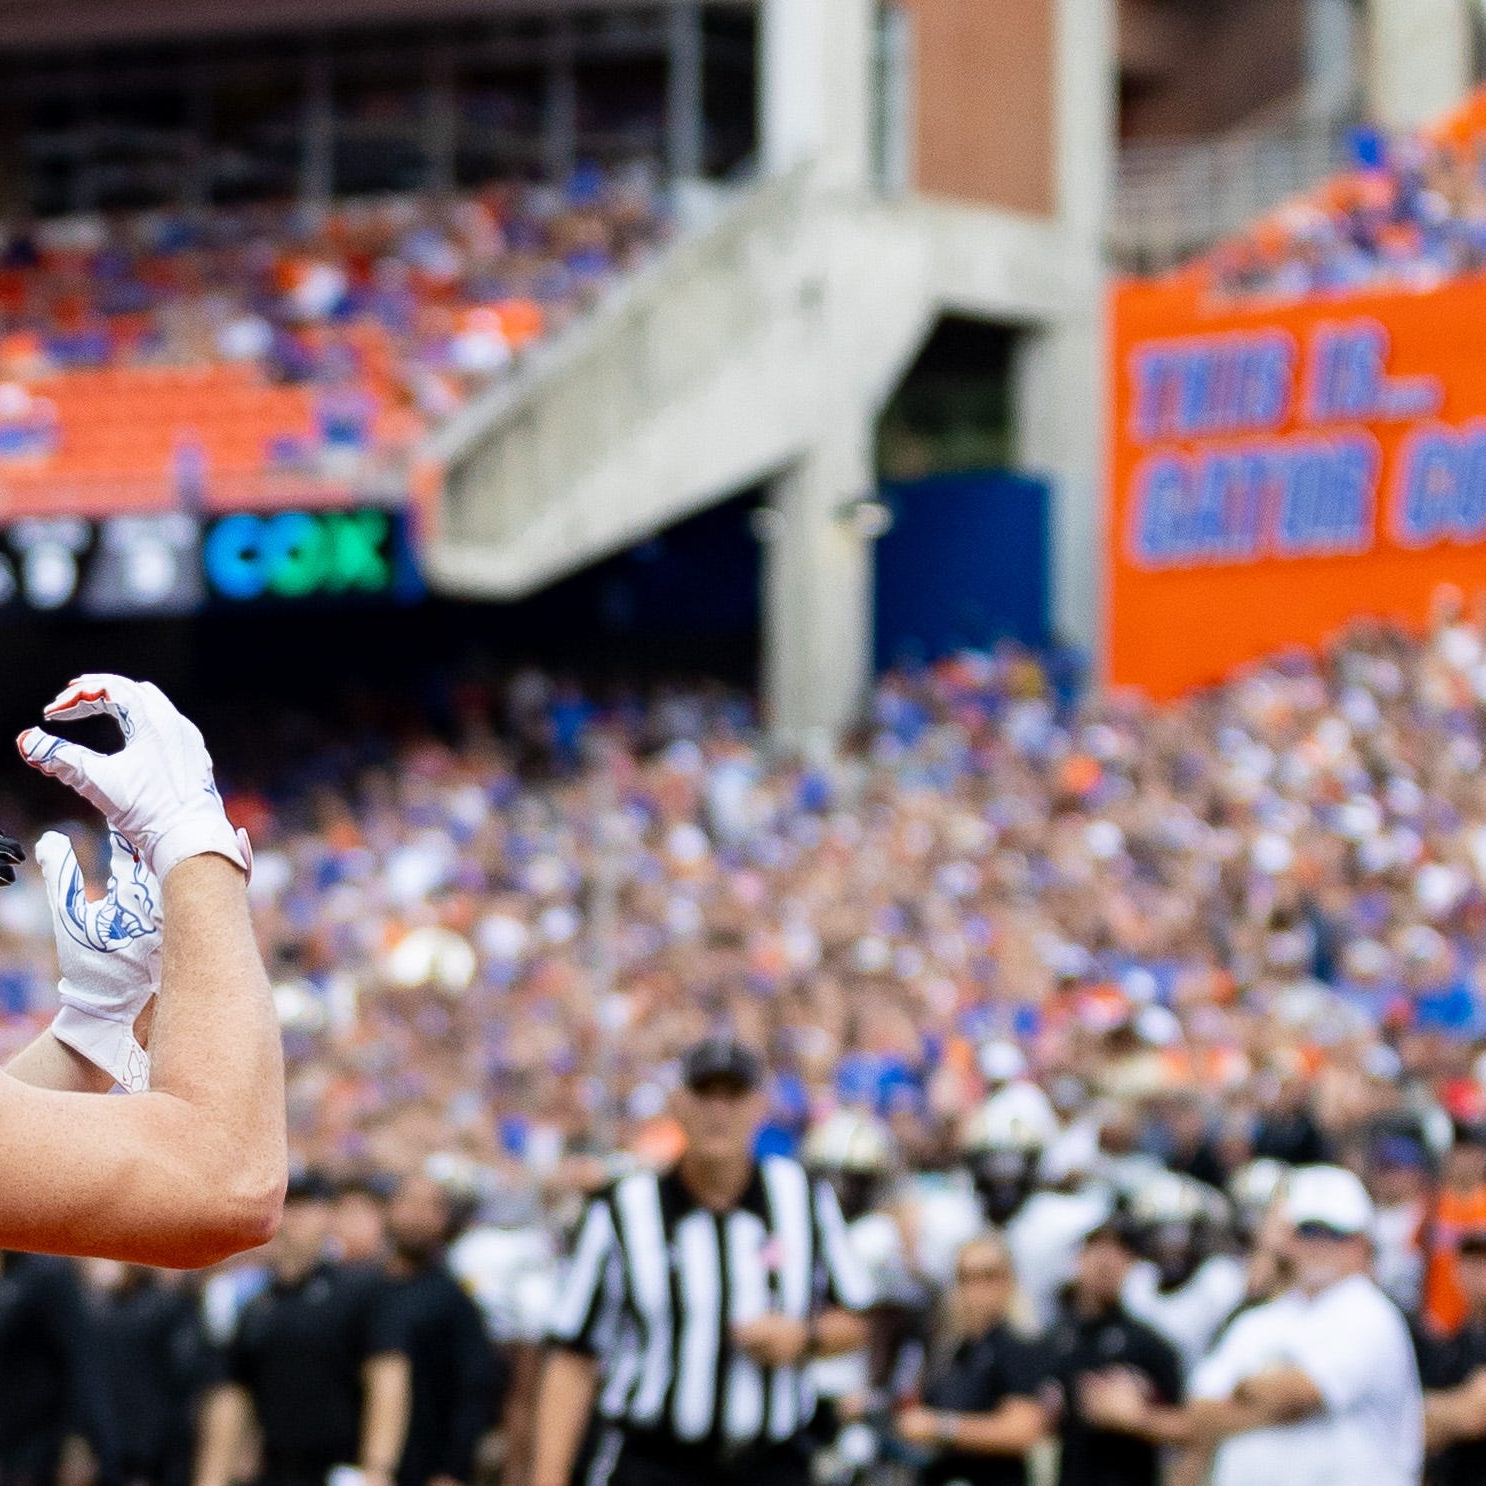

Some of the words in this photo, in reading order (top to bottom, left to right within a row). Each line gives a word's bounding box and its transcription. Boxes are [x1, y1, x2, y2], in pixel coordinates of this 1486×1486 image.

[1132, 330, 1293, 443] THIS
[206, 510, 389, 598] COX
[1126, 437, 1378, 566] GATOR
